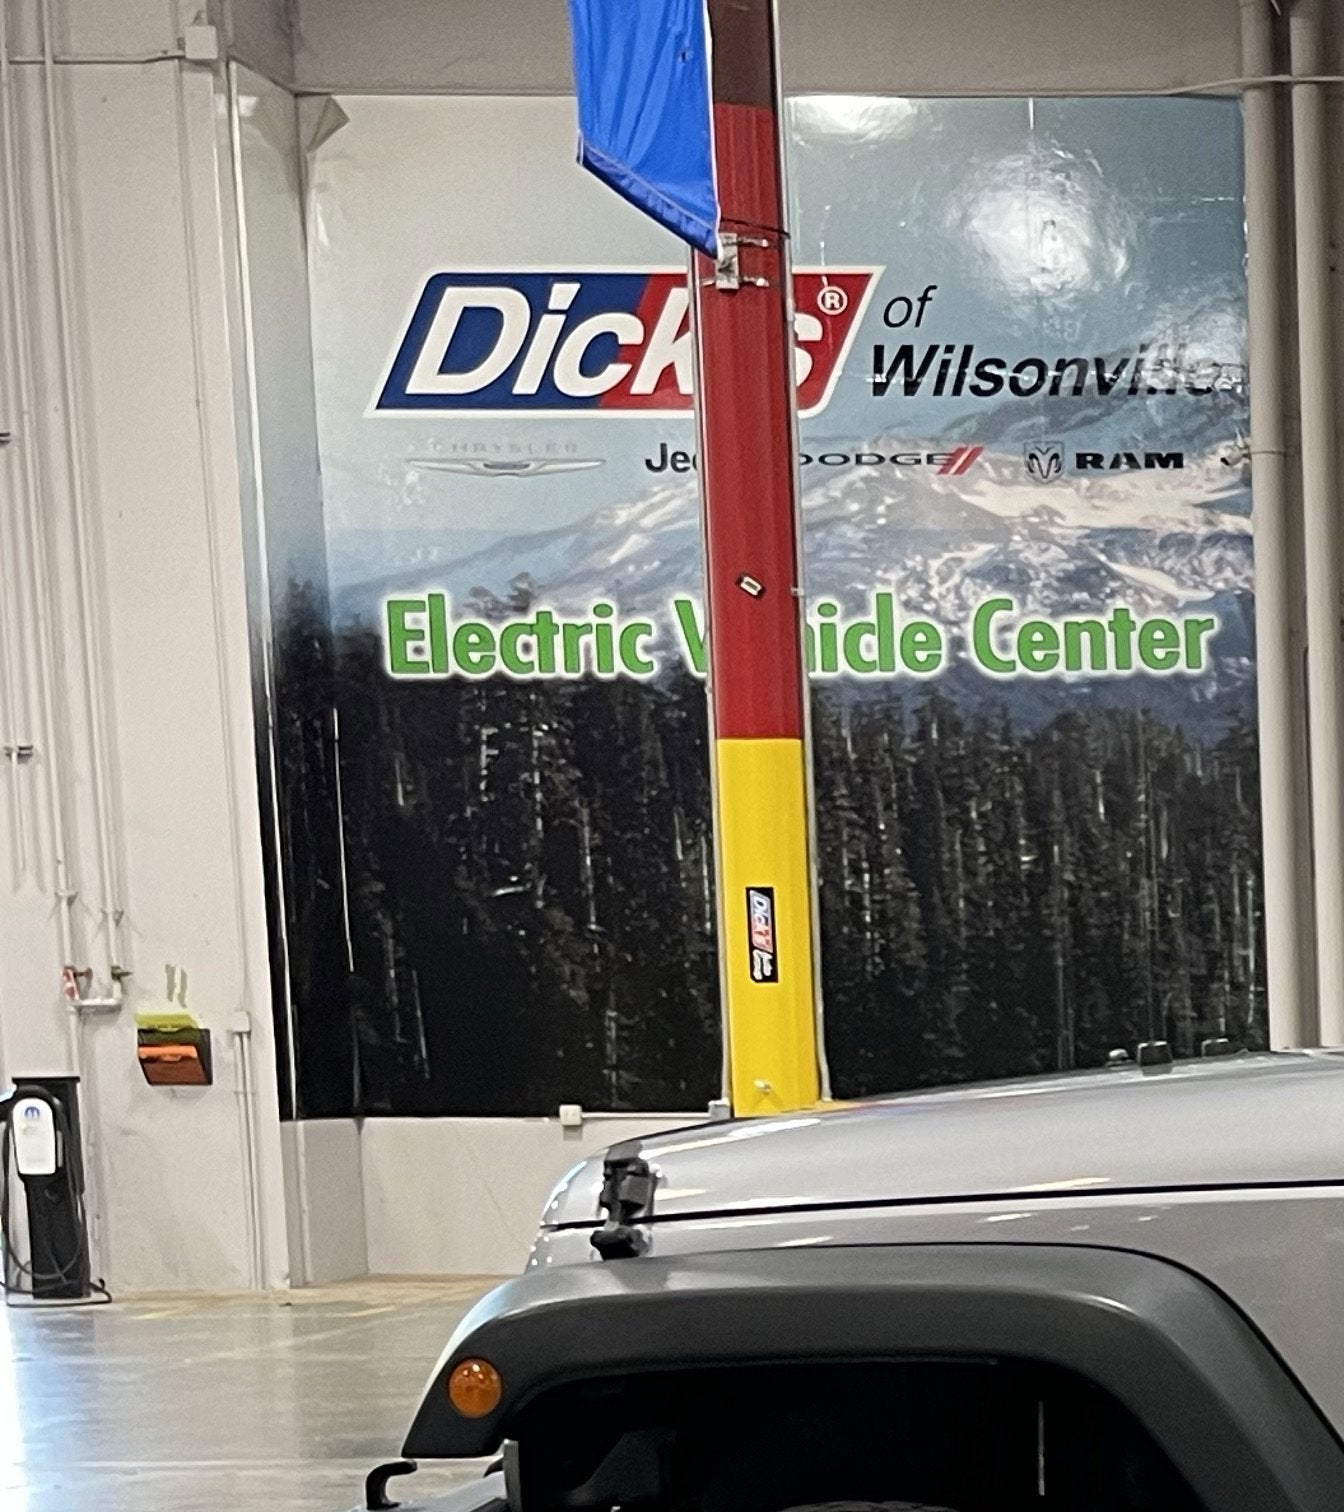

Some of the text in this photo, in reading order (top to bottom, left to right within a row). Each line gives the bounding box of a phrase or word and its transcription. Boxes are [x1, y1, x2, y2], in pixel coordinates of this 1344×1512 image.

[405, 282, 938, 397] Dick of
[645, 442, 698, 473] Je
[1075, 452, 1184, 469] RAM
[387, 592, 1215, 674] Electric Vicle Center
